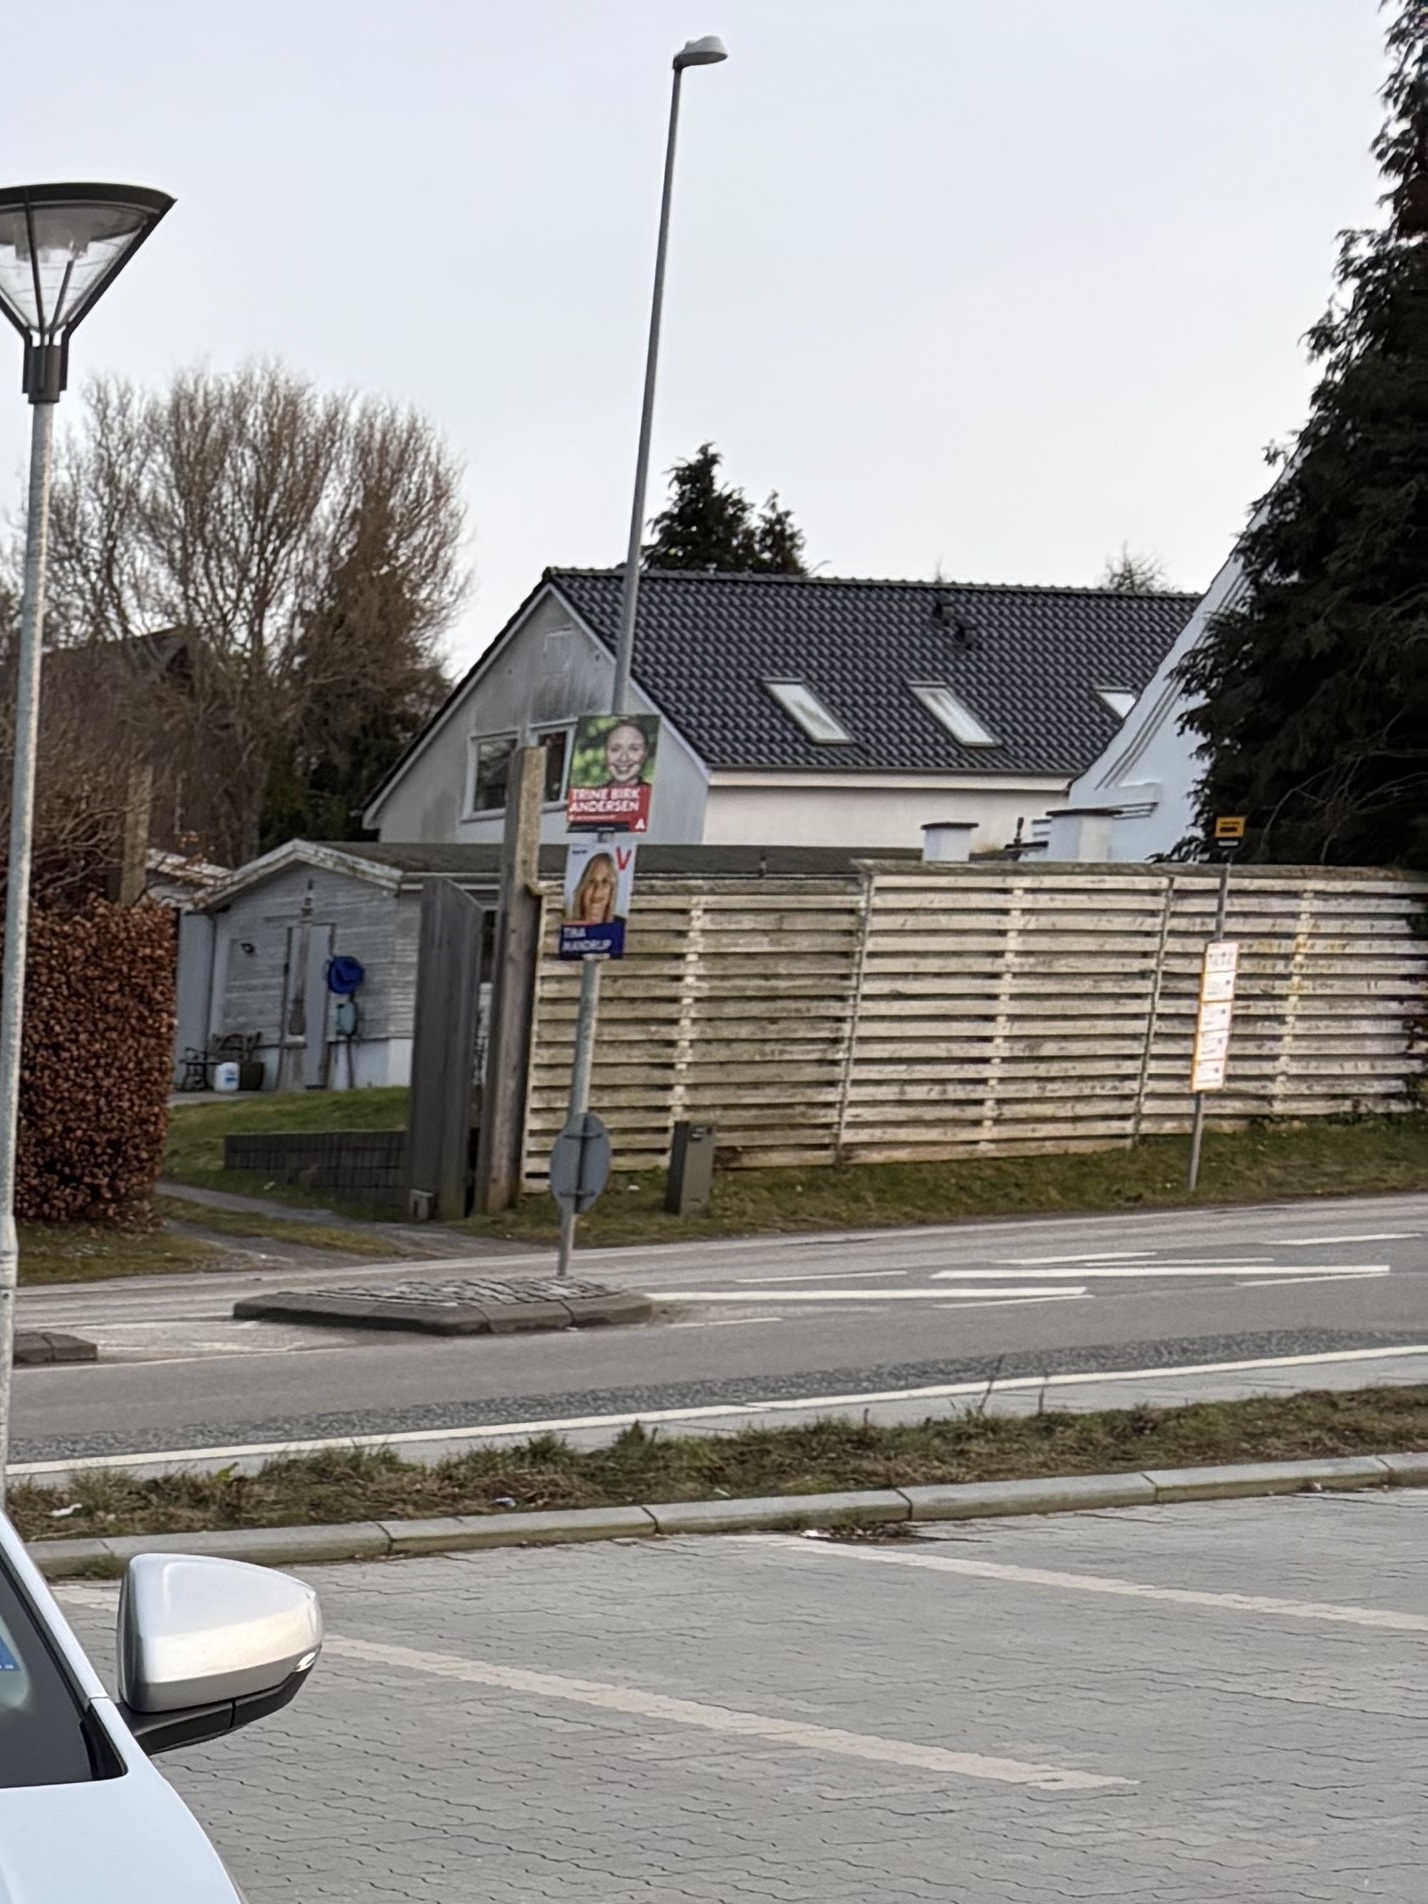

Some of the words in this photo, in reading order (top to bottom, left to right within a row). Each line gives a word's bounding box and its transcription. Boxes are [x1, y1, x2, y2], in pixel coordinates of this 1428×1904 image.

[571, 788, 609, 800] TRINE
[611, 787, 640, 800] BIRK
[569, 800, 639, 812] ANDERSEN
[615, 845, 632, 871] V
